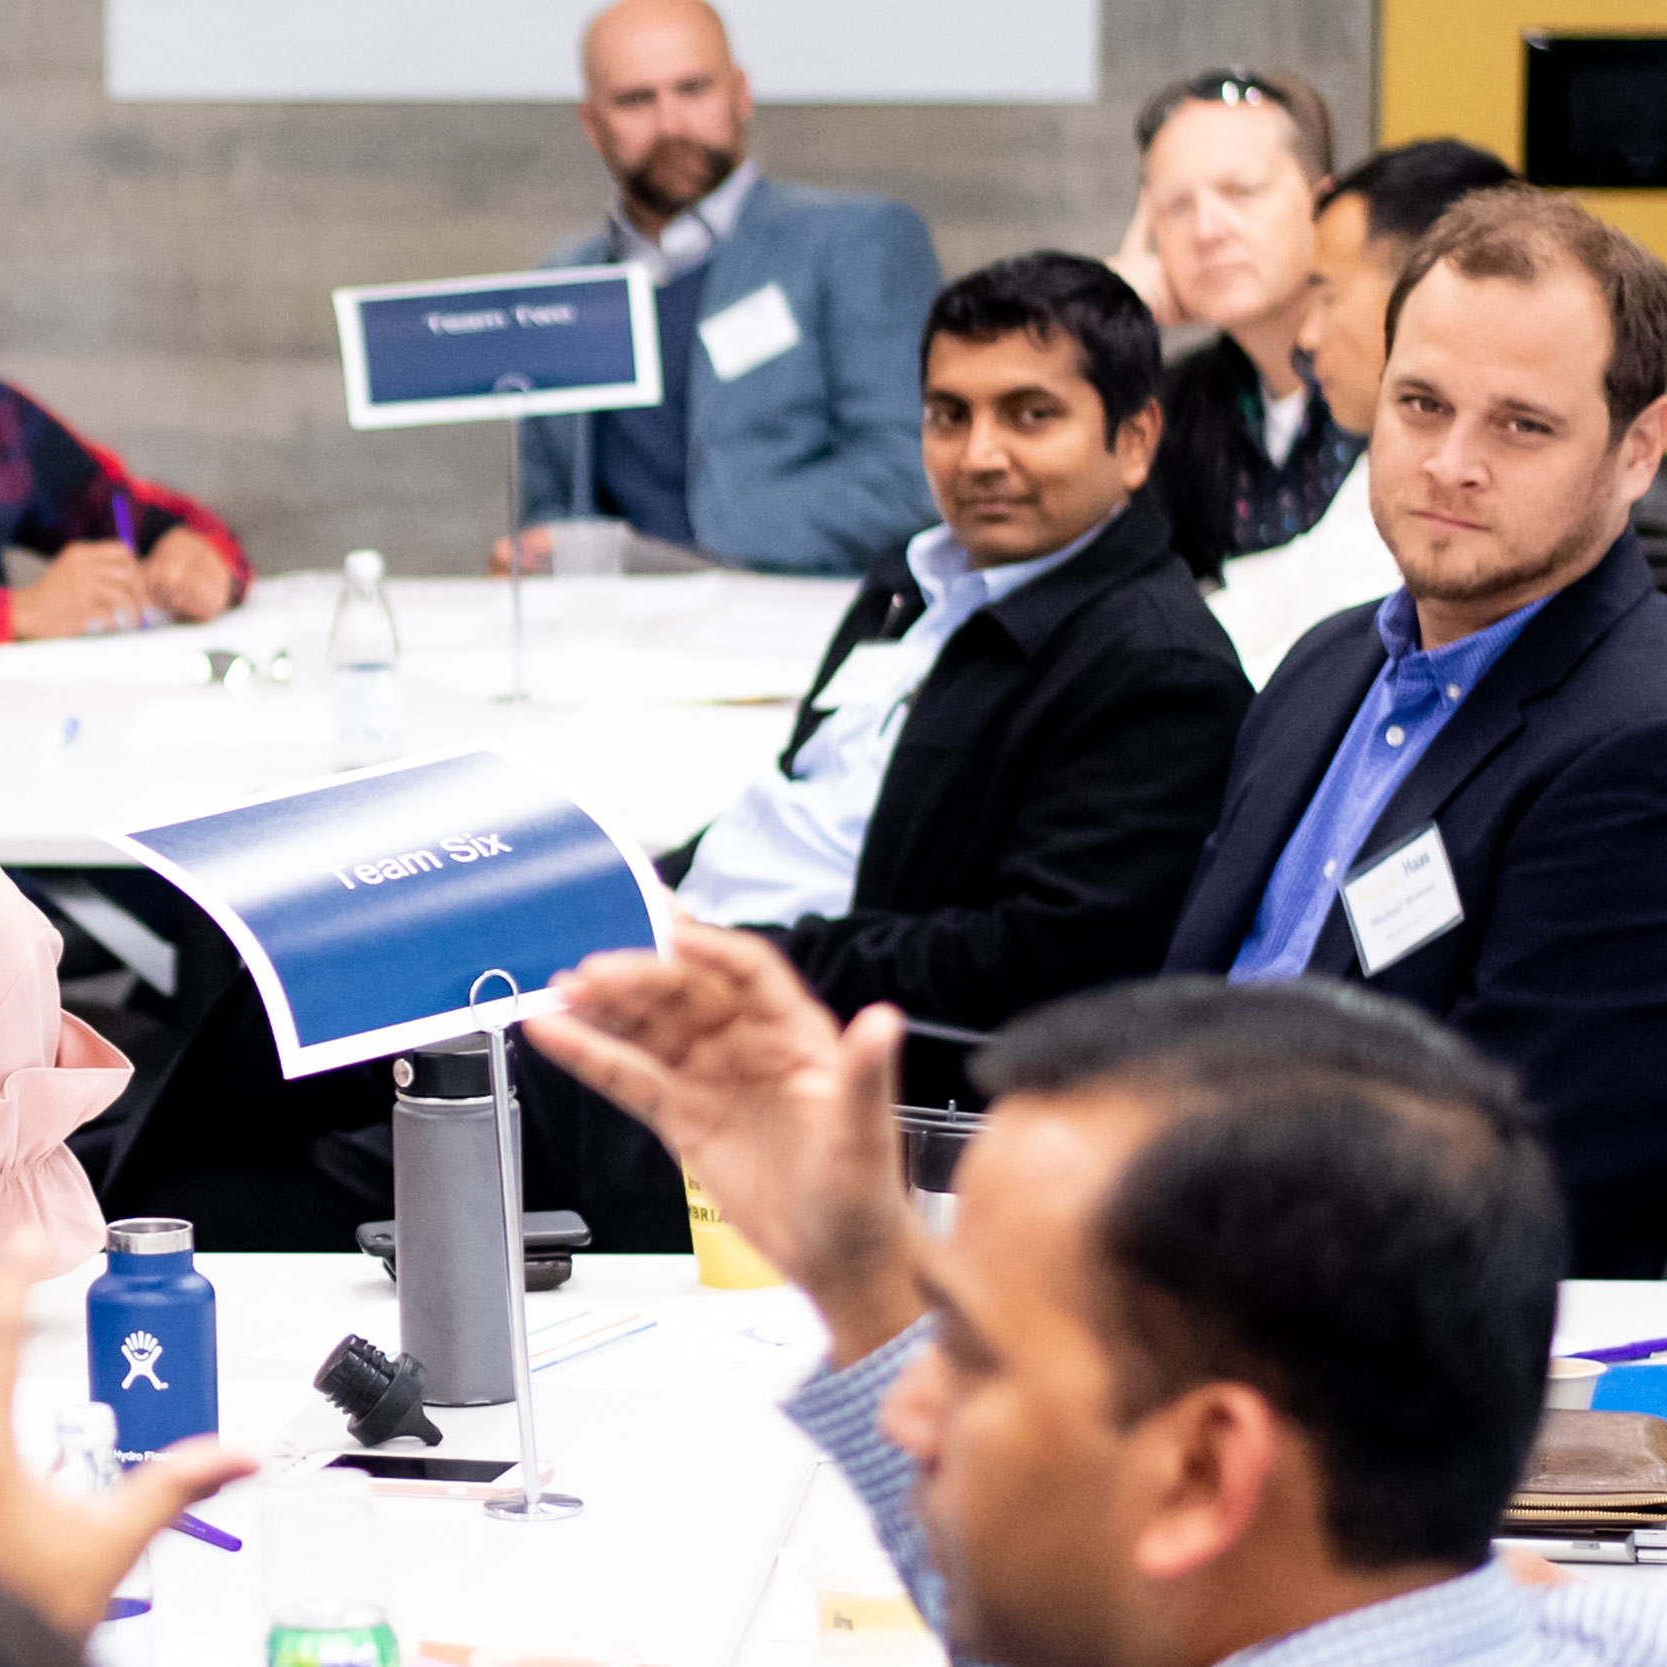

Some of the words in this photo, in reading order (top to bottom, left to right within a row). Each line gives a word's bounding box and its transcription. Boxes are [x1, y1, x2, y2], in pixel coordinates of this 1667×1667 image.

[427, 311, 507, 336] Team
[515, 304, 577, 328] Two
[330, 849, 443, 890] Team
[439, 833, 513, 864] Six
[114, 1449, 144, 1463] Hydro
